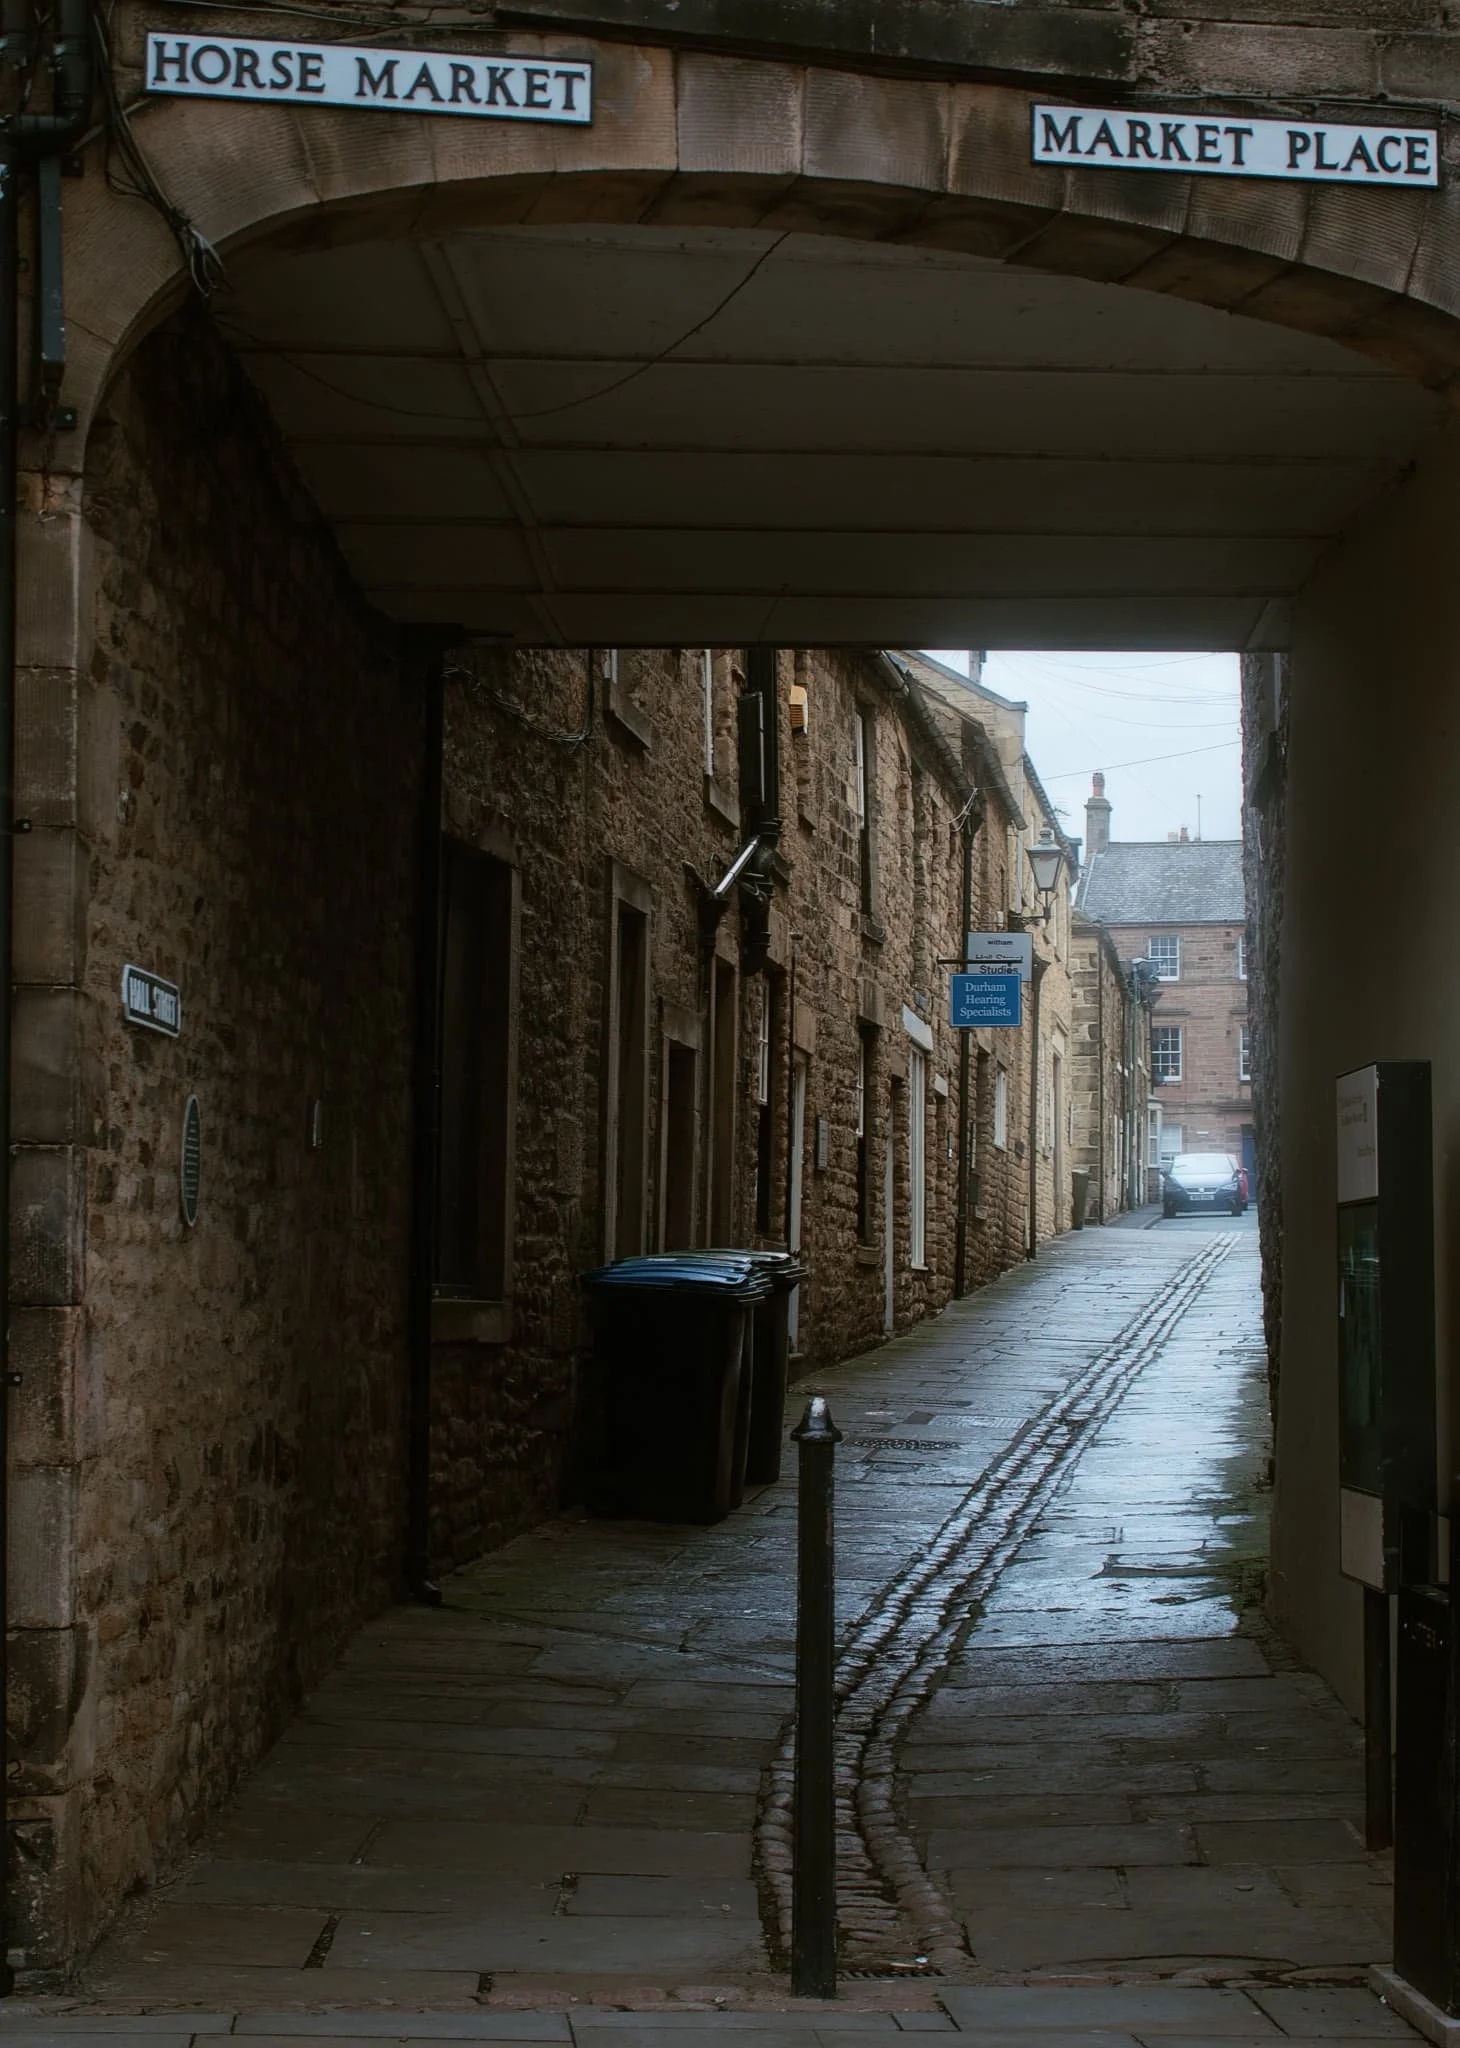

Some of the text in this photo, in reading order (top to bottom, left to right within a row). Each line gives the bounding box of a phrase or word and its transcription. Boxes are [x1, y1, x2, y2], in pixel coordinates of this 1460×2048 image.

[153, 41, 586, 111] HORSE MARKET
[1040, 113, 1432, 176] MARKET PLACE
[965, 982, 1006, 992] Durham
[966, 995, 1006, 1005] Hearing
[960, 1007, 1012, 1019] Specialists
